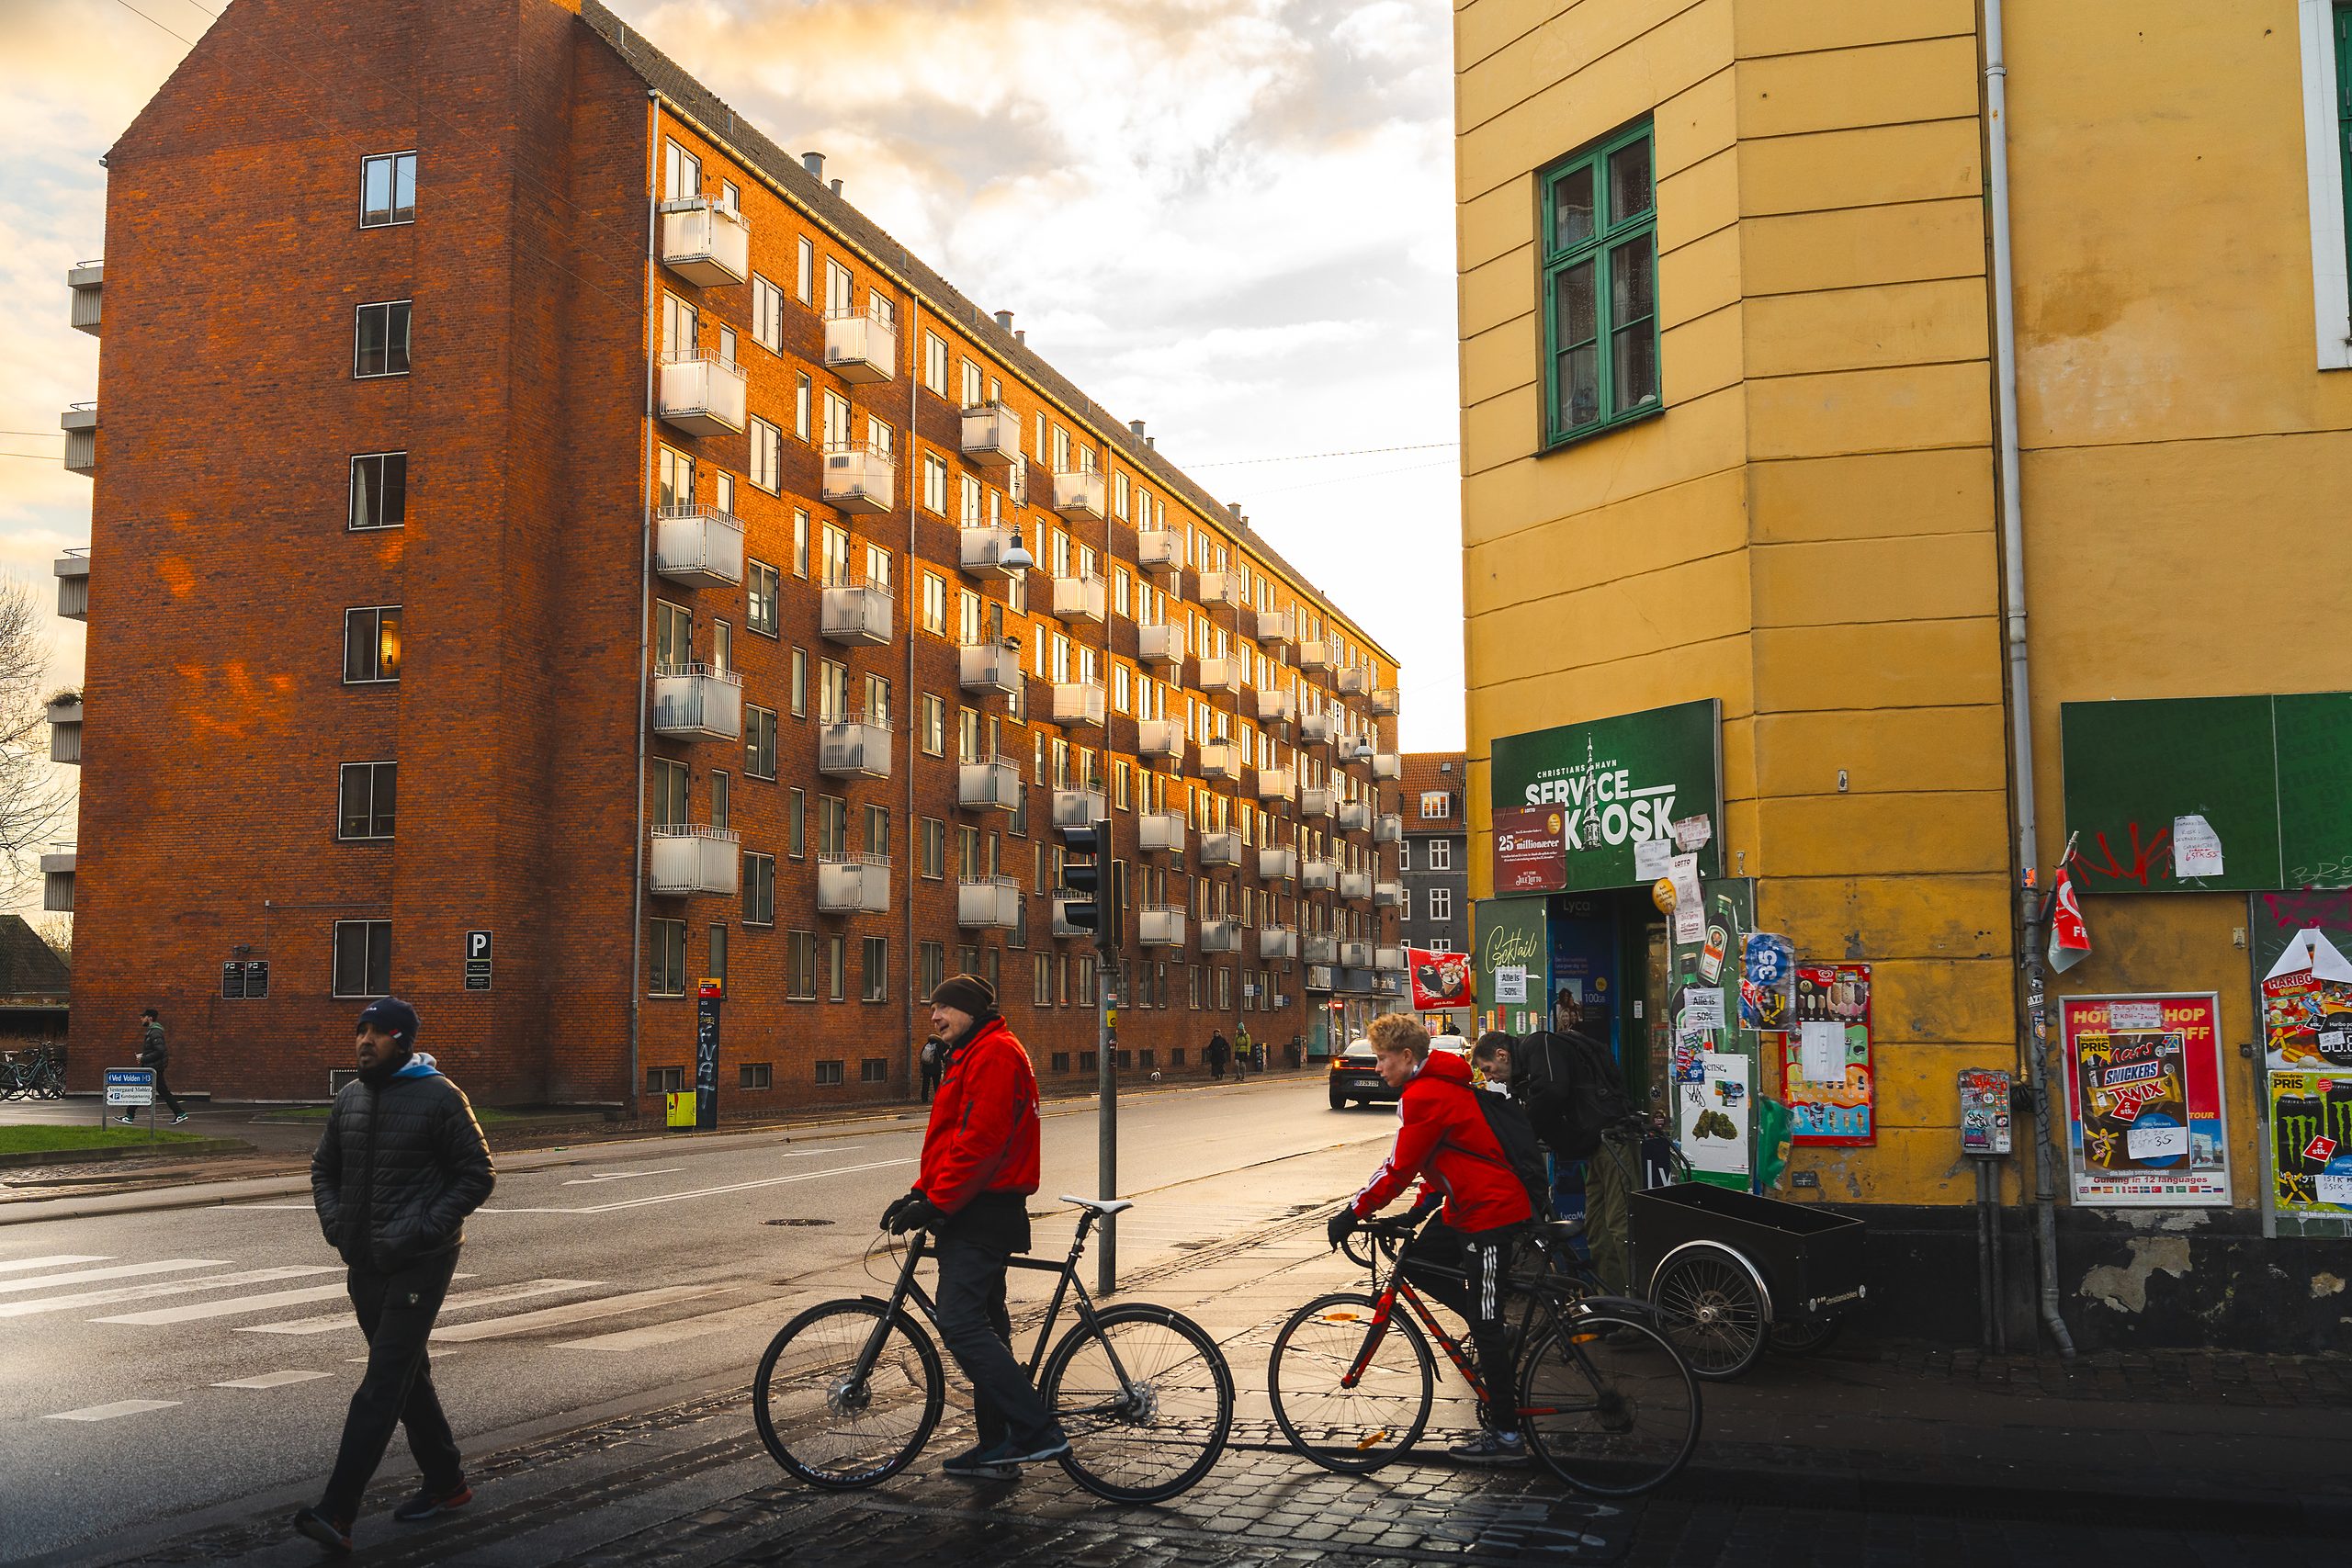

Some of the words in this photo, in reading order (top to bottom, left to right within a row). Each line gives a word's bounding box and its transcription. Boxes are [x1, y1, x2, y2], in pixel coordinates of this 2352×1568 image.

[1498, 834, 1514, 852] 25
[1516, 840, 1560, 851] millionærer
[1674, 859, 1691, 867] LOTTO
[1563, 898, 1590, 913] Lyca
[472, 933, 487, 957] P
[1485, 925, 1537, 974] Cocktail
[2268, 973, 2314, 989] HARIBO
[1504, 987, 1518, 997] 50%
[1693, 996, 1708, 1006] Alle
[1709, 996, 1715, 1005] is
[1697, 1011, 1713, 1021] 50%
[2164, 1008, 2206, 1022] HOP
[2080, 1043, 2109, 1052] PRIS
[112, 1074, 121, 1082] Ved
[123, 1074, 141, 1082] Volden
[2105, 1062, 2157, 1085] SNICKERS
[2273, 1078, 2303, 1089] PRIS
[2107, 1080, 2166, 1102] TWIX
[2188, 1111, 2215, 1120] TOUR
[2093, 1176, 2129, 1185] Guiding
[2158, 1176, 2208, 1185] languages
